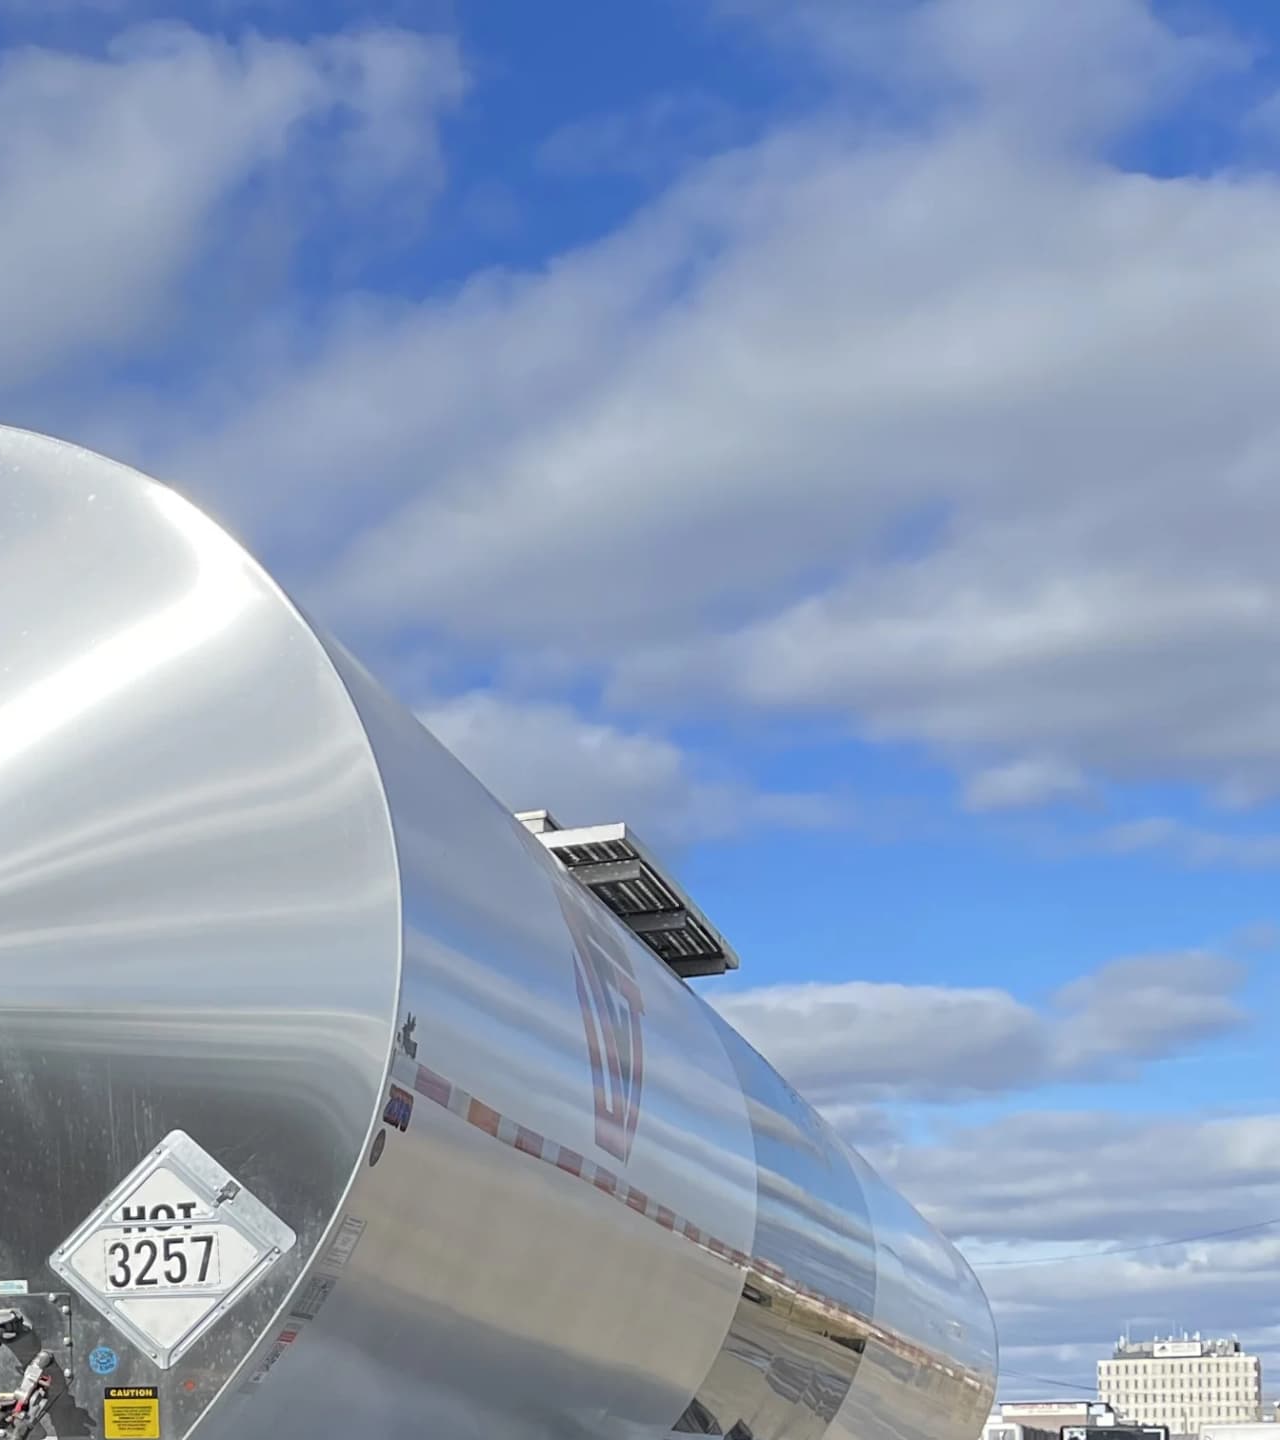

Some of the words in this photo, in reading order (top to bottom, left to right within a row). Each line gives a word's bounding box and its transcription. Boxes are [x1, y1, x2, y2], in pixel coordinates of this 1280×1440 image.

[122, 1201, 197, 1234] HOT
[108, 1234, 214, 1288] 3257
[109, 1388, 153, 1398] CAUTION
